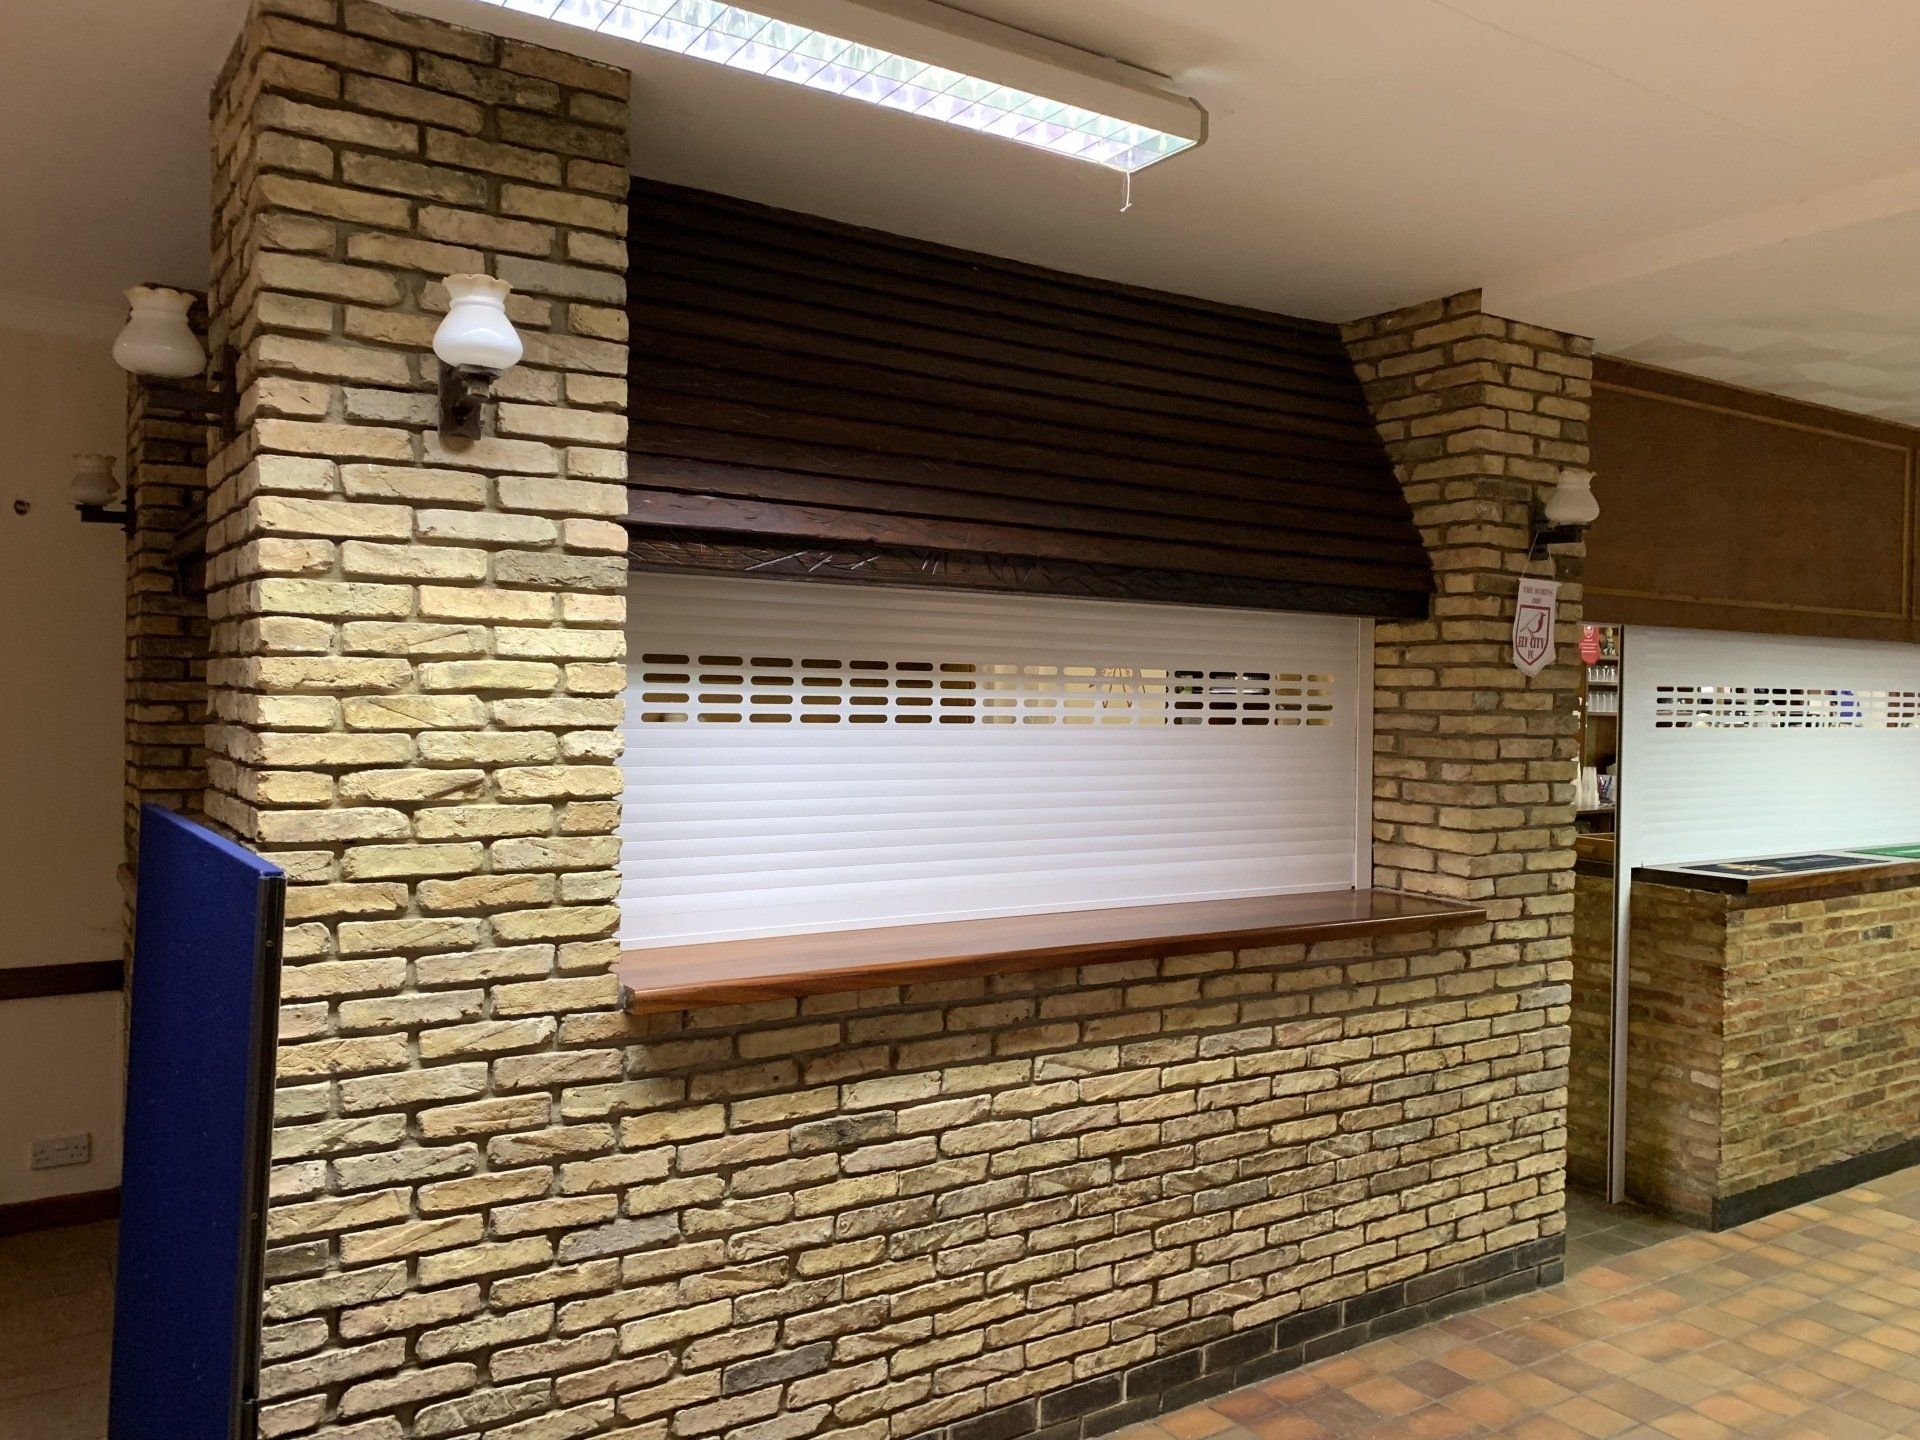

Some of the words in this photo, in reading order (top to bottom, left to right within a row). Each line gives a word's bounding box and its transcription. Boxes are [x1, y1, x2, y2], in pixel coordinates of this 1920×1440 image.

[1518, 636, 1529, 648] ELY
[1530, 637, 1545, 649] CITY
[1528, 650, 1534, 659] FC
